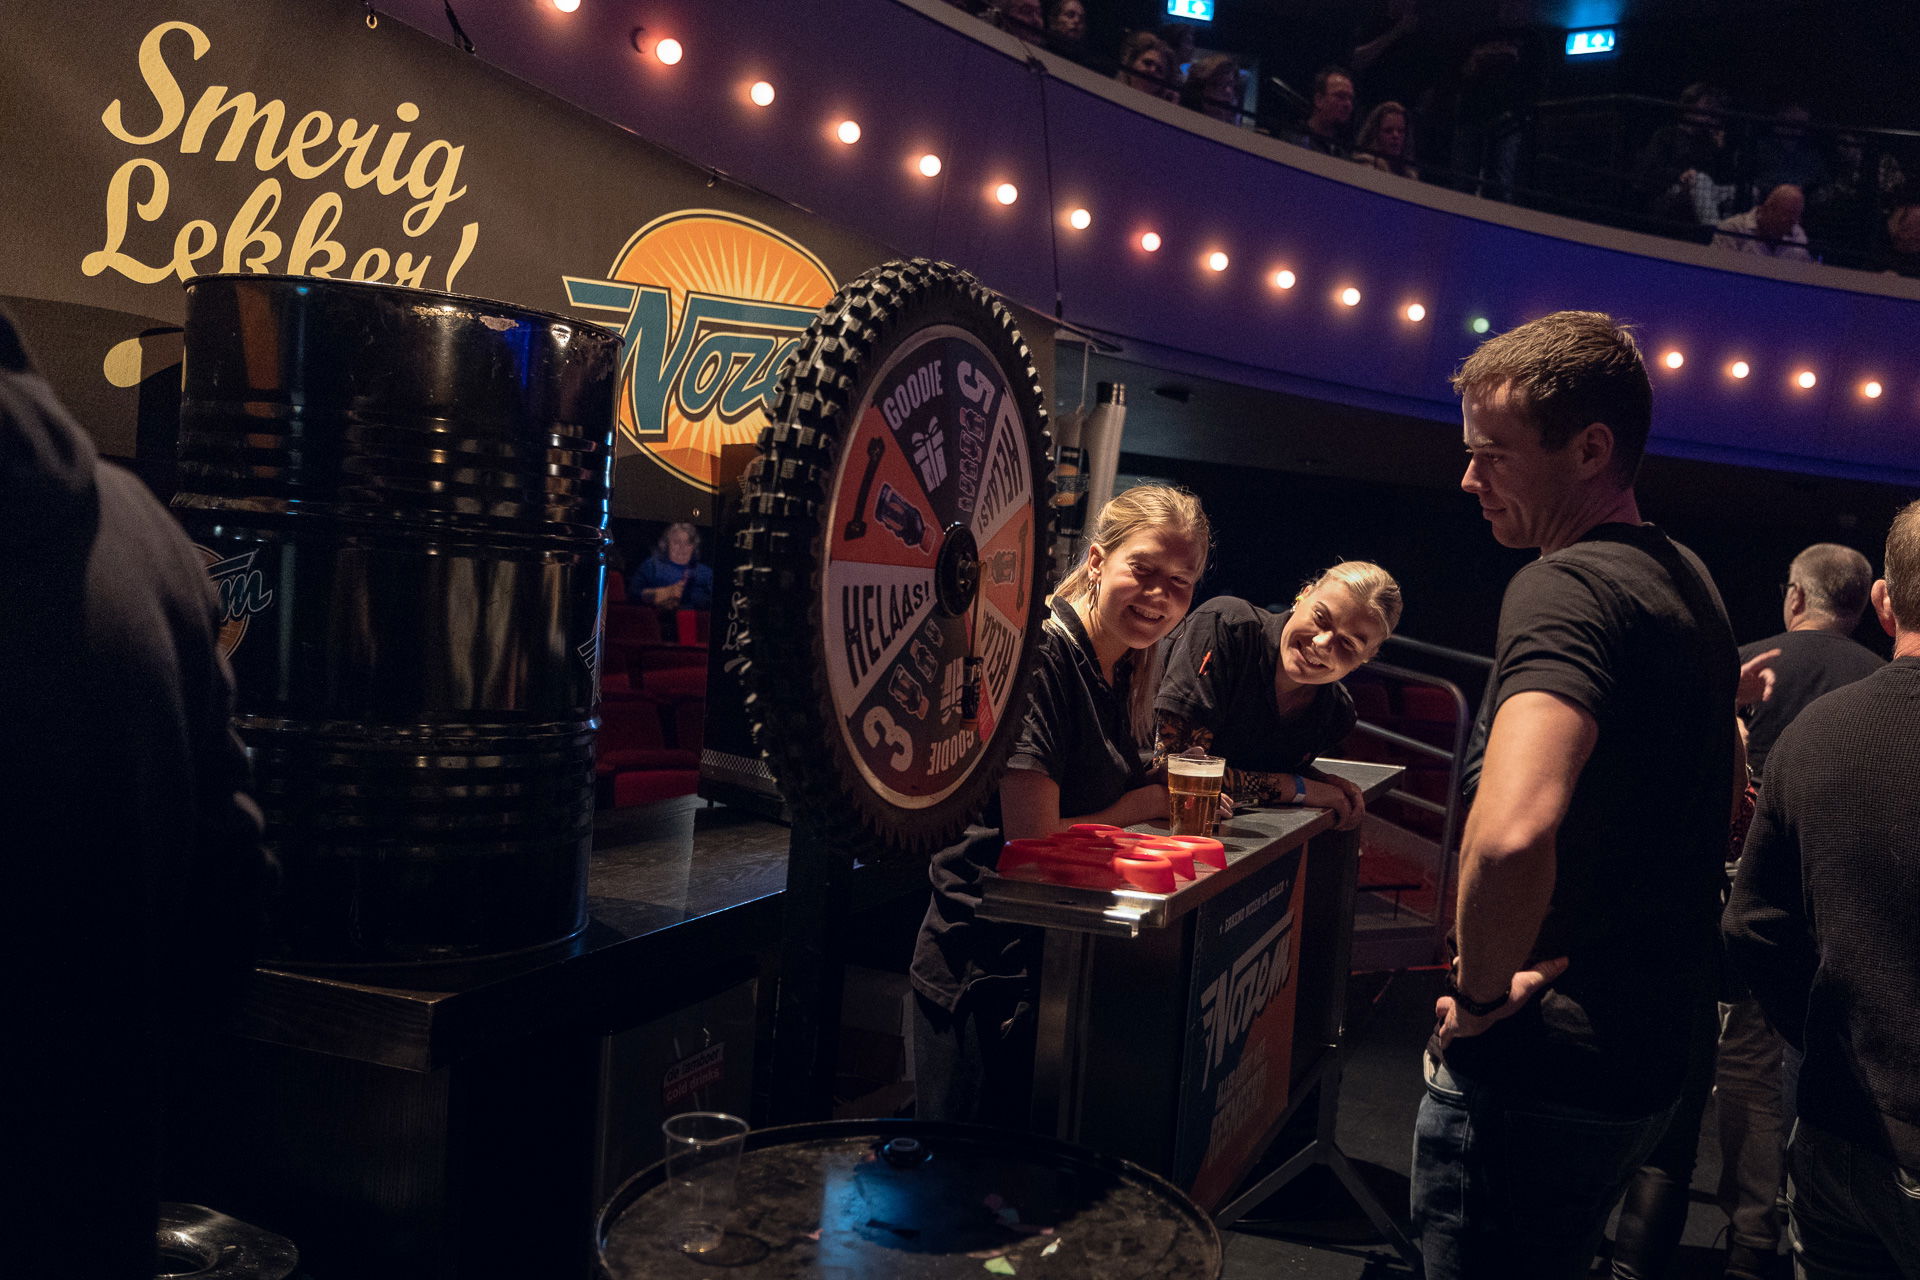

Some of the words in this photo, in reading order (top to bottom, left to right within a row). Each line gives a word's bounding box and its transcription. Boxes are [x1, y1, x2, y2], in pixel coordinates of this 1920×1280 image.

[101, 21, 467, 237] Smerig
[883, 360, 943, 431] GOODIE
[977, 414, 1024, 534] HELAAS!
[842, 581, 930, 687] HELAAS!
[863, 705, 913, 772] 3
[927, 729, 975, 776] GOODIE
